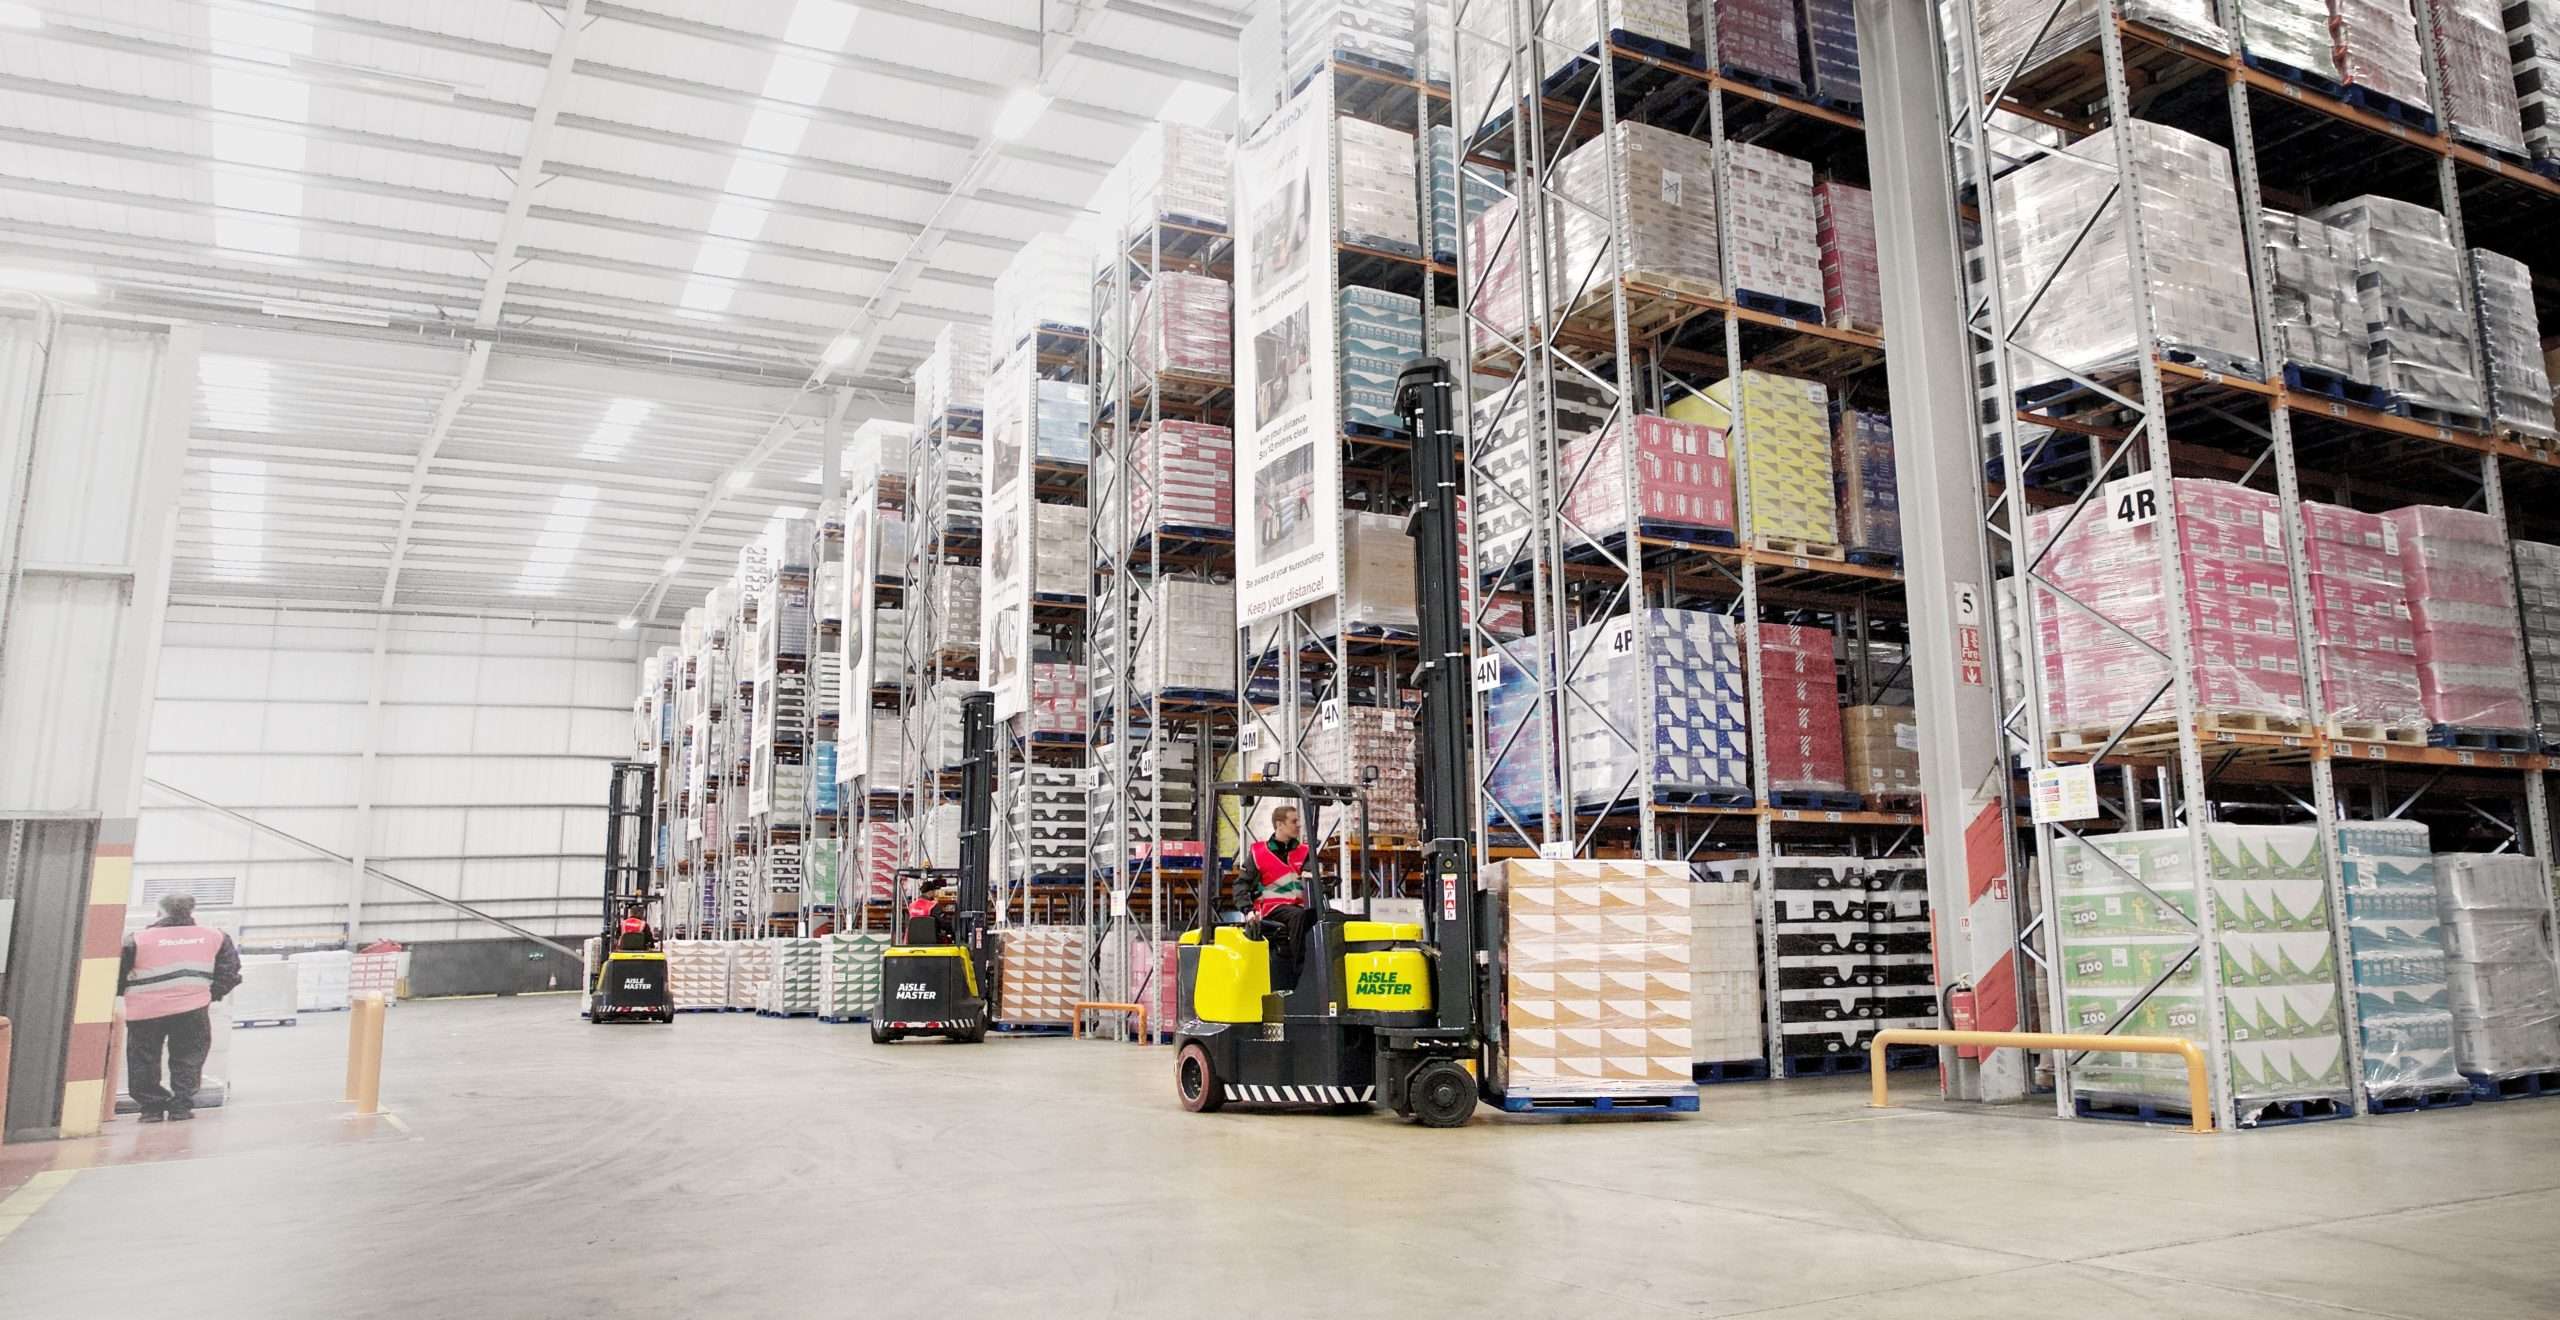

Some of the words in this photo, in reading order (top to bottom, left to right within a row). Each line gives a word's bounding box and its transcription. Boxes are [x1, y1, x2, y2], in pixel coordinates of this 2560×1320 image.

[2117, 488, 2157, 523] 4R
[1247, 600, 1267, 617] Keep
[1267, 593, 1286, 612] your
[1286, 575, 1325, 601] distance!
[1962, 592, 1973, 614] 5
[1962, 647, 1979, 659] Fire
[1477, 660, 1497, 684] 4N
[1242, 731, 1256, 749] 4M
[2153, 853, 2180, 869] ZOO
[2072, 910, 2098, 925] ZOO
[158, 937, 206, 946] Stobart
[2078, 960, 2104, 975] ZOO
[895, 991, 937, 1000] MASTER
[1356, 983, 1412, 995] MASTER
[2081, 1011, 2107, 1025] ZOO
[2168, 1012, 2197, 1026] ZOO
